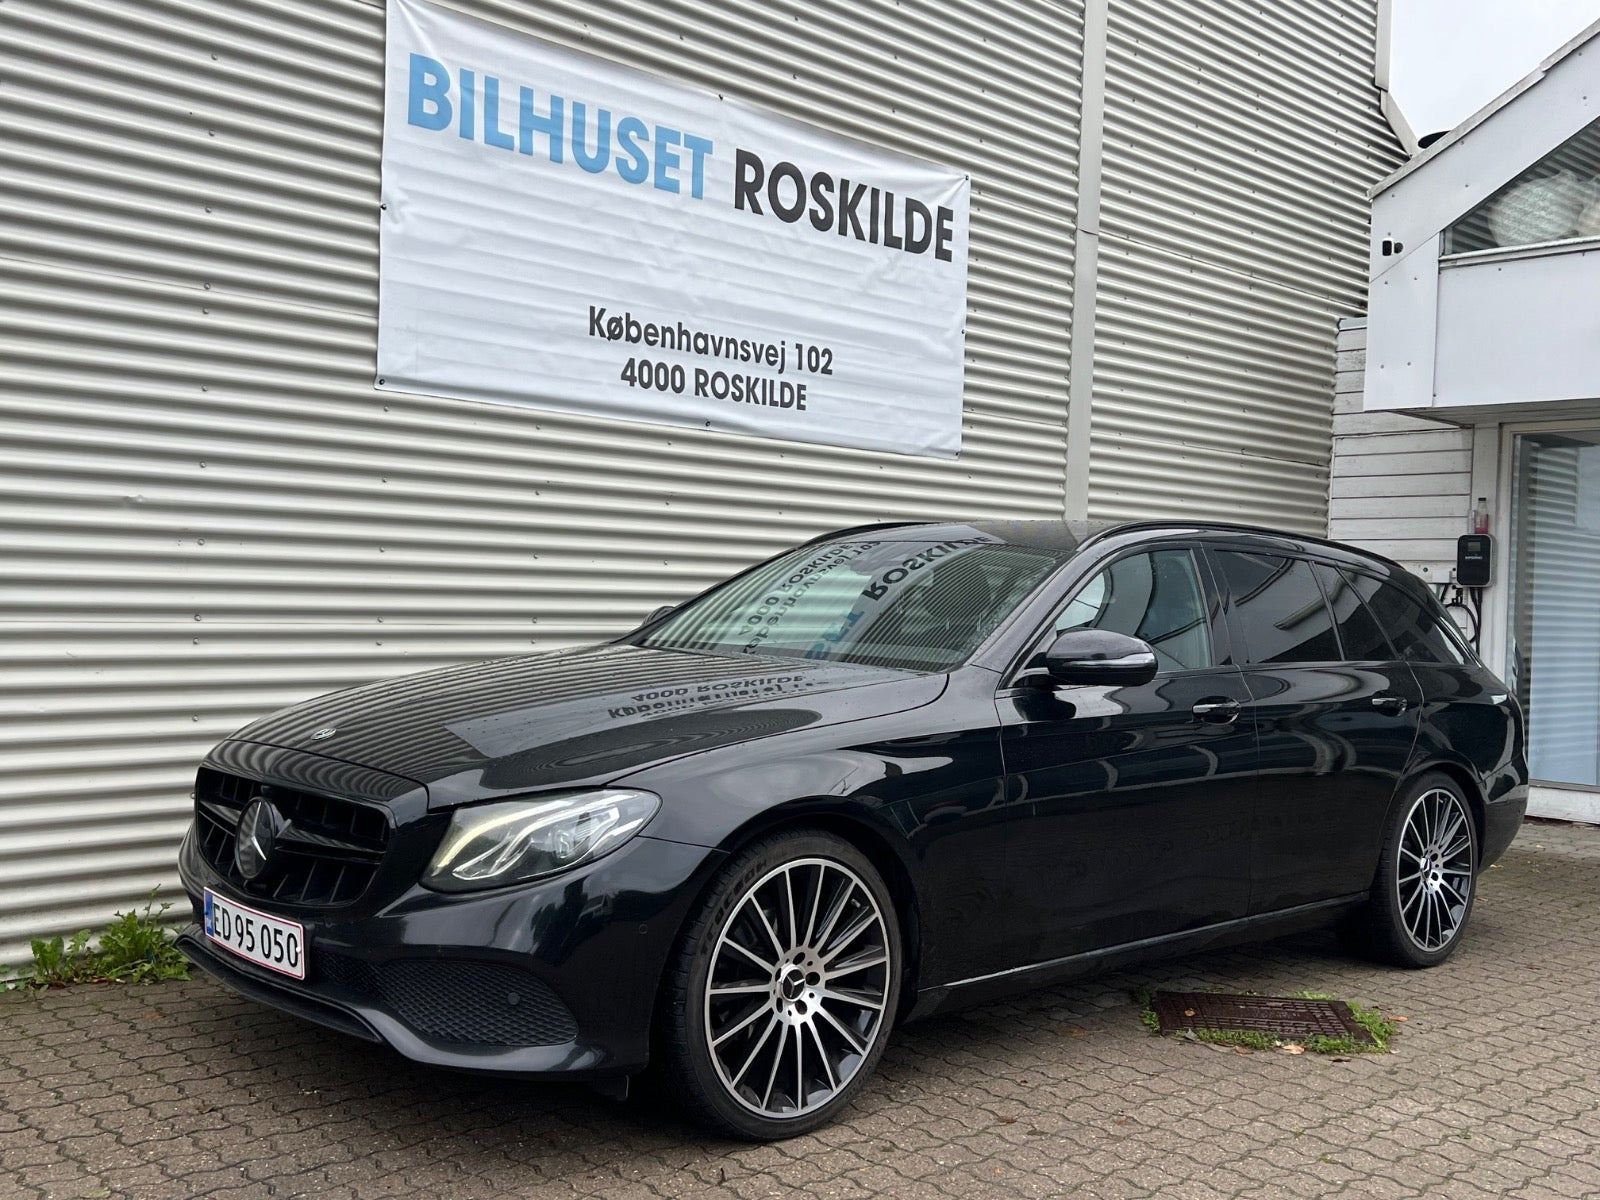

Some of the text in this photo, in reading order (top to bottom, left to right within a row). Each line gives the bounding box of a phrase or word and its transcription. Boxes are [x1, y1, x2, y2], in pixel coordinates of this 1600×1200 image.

[407, 53, 954, 263] BILHUSET ROSKILDE
[589, 305, 833, 376] Københavnsvej 102
[620, 357, 807, 411] 4000 ROSKILDE
[212, 902, 299, 968] ED 95 050
